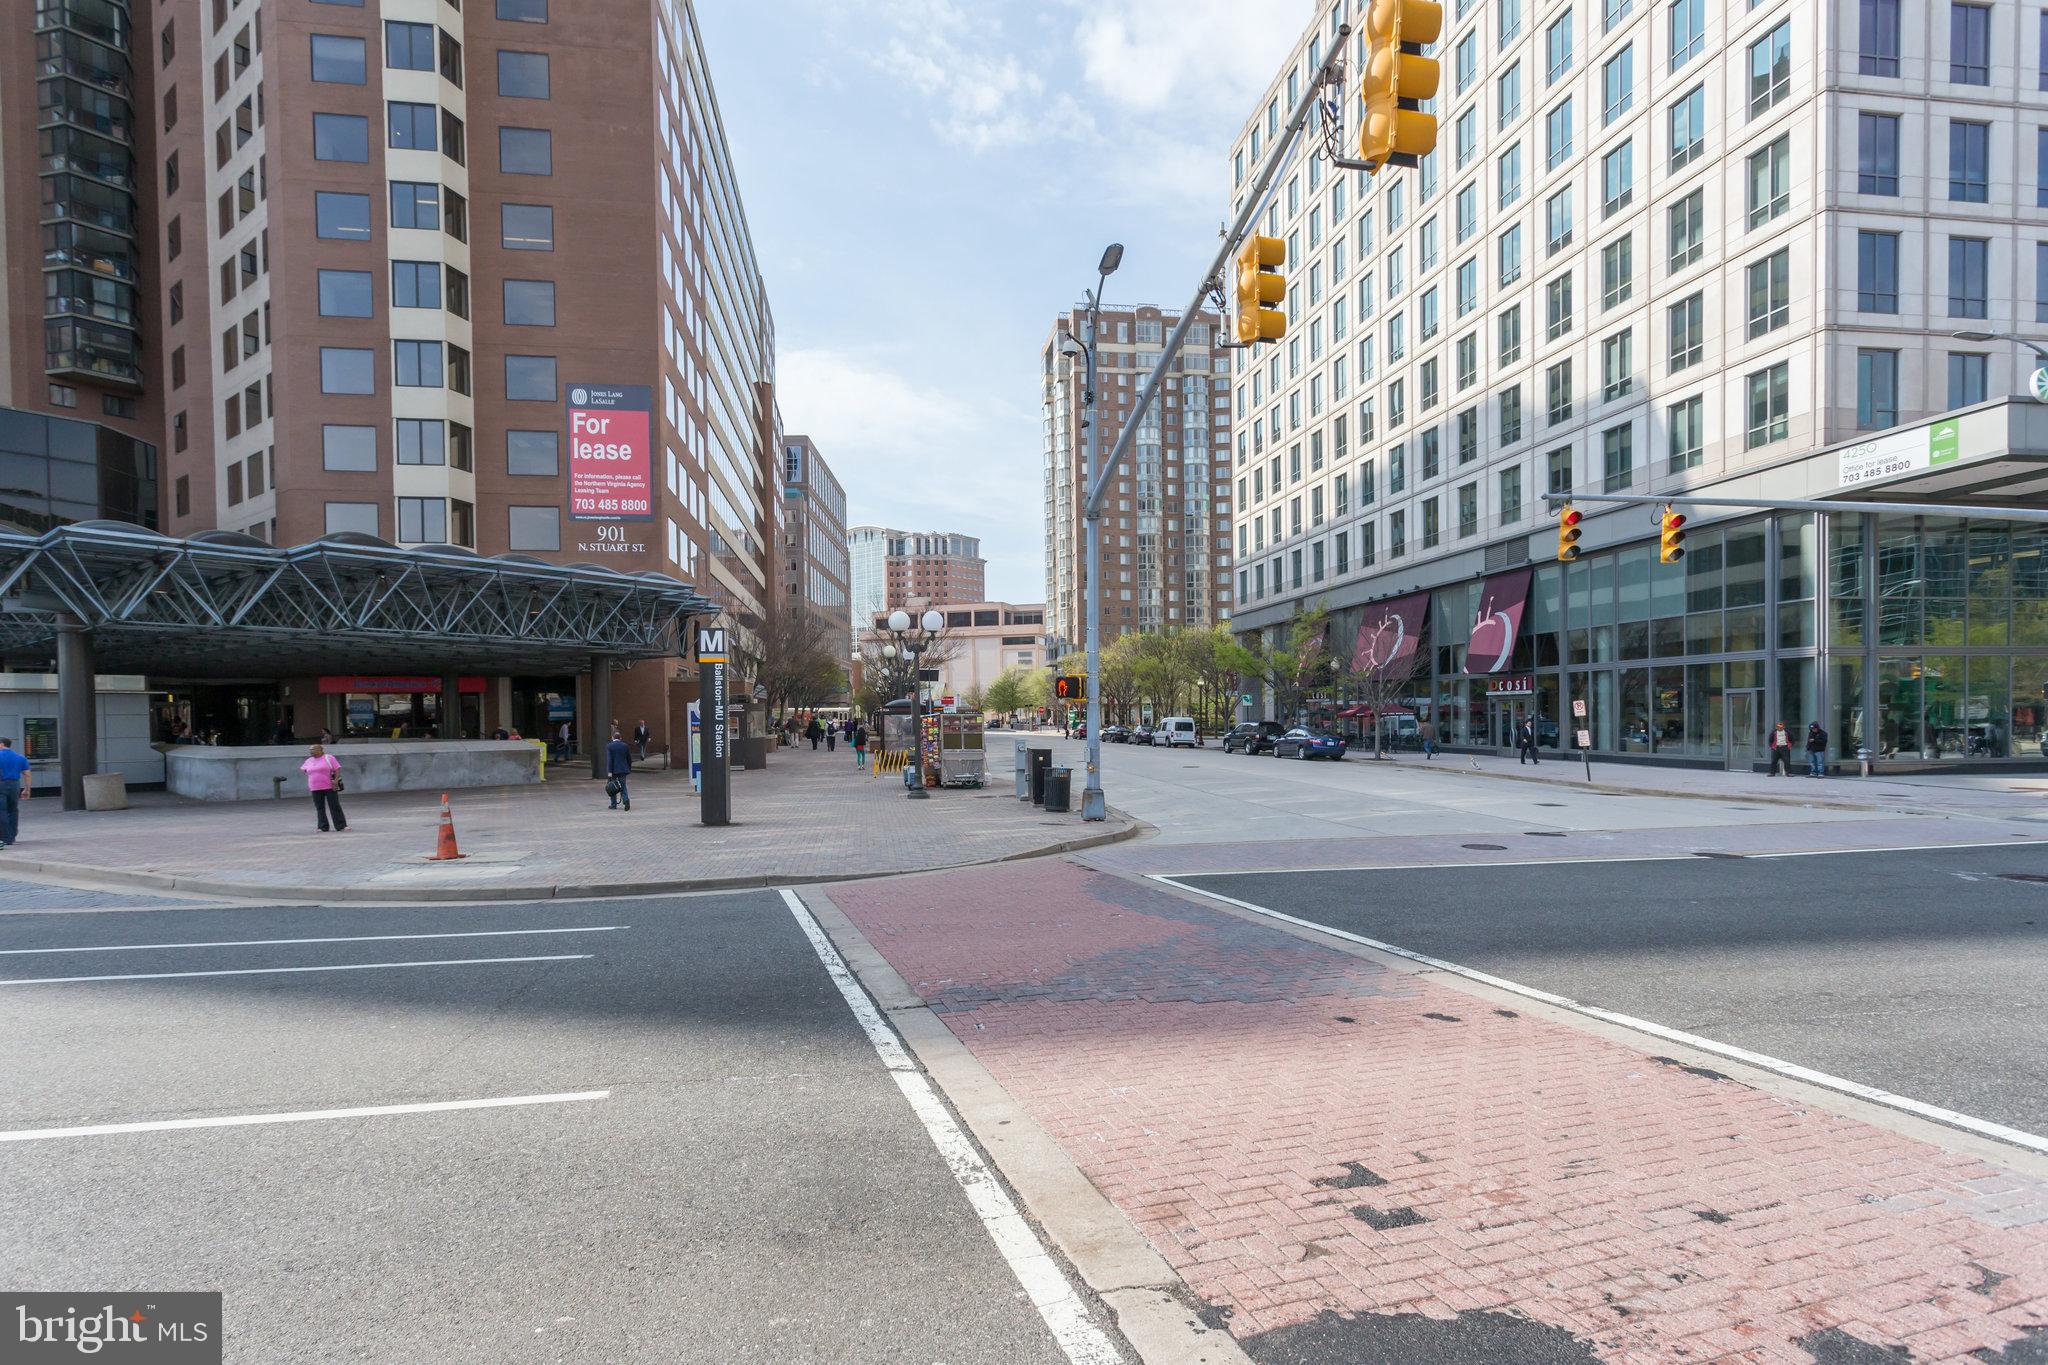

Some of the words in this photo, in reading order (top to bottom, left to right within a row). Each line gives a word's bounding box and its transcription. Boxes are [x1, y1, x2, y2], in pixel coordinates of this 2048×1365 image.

[573, 412, 610, 435] For
[573, 437, 632, 461] lease
[1843, 443, 1877, 458] 4250
[1843, 473, 1860, 483] 703
[1864, 467, 1881, 477] 485
[1885, 460, 1911, 473] 8800
[575, 499, 595, 510] 703
[598, 499, 618, 510] 485
[621, 499, 647, 511] 8800
[597, 525, 625, 541] 901
[578, 543, 588, 551] N.
[590, 543, 629, 552] STUART
[632, 543, 646, 552] ST.
[700, 630, 723, 652] M
[714, 663, 724, 720] Ballston-MU
[715, 724, 725, 758] Station
